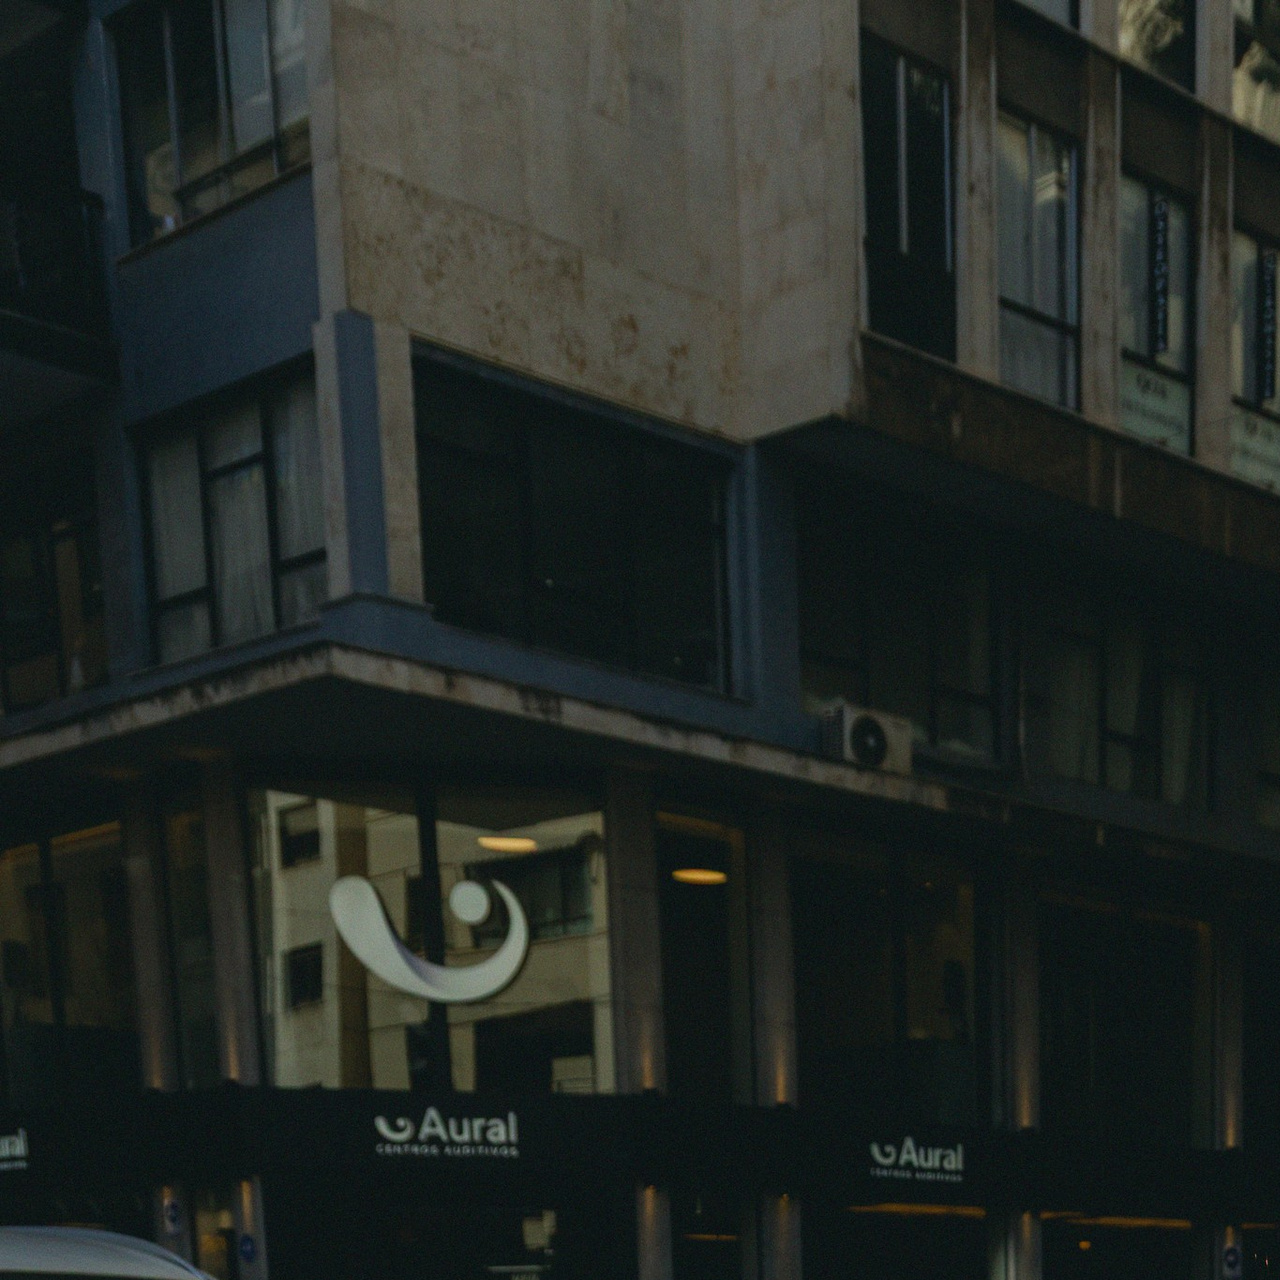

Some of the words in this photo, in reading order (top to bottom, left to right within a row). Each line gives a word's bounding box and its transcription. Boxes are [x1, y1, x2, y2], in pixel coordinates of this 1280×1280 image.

[418, 1106, 519, 1144] Aural
[375, 1143, 439, 1157] CENTROS
[444, 1144, 519, 1159] AUDITIVOS
[898, 1136, 964, 1171] Aural
